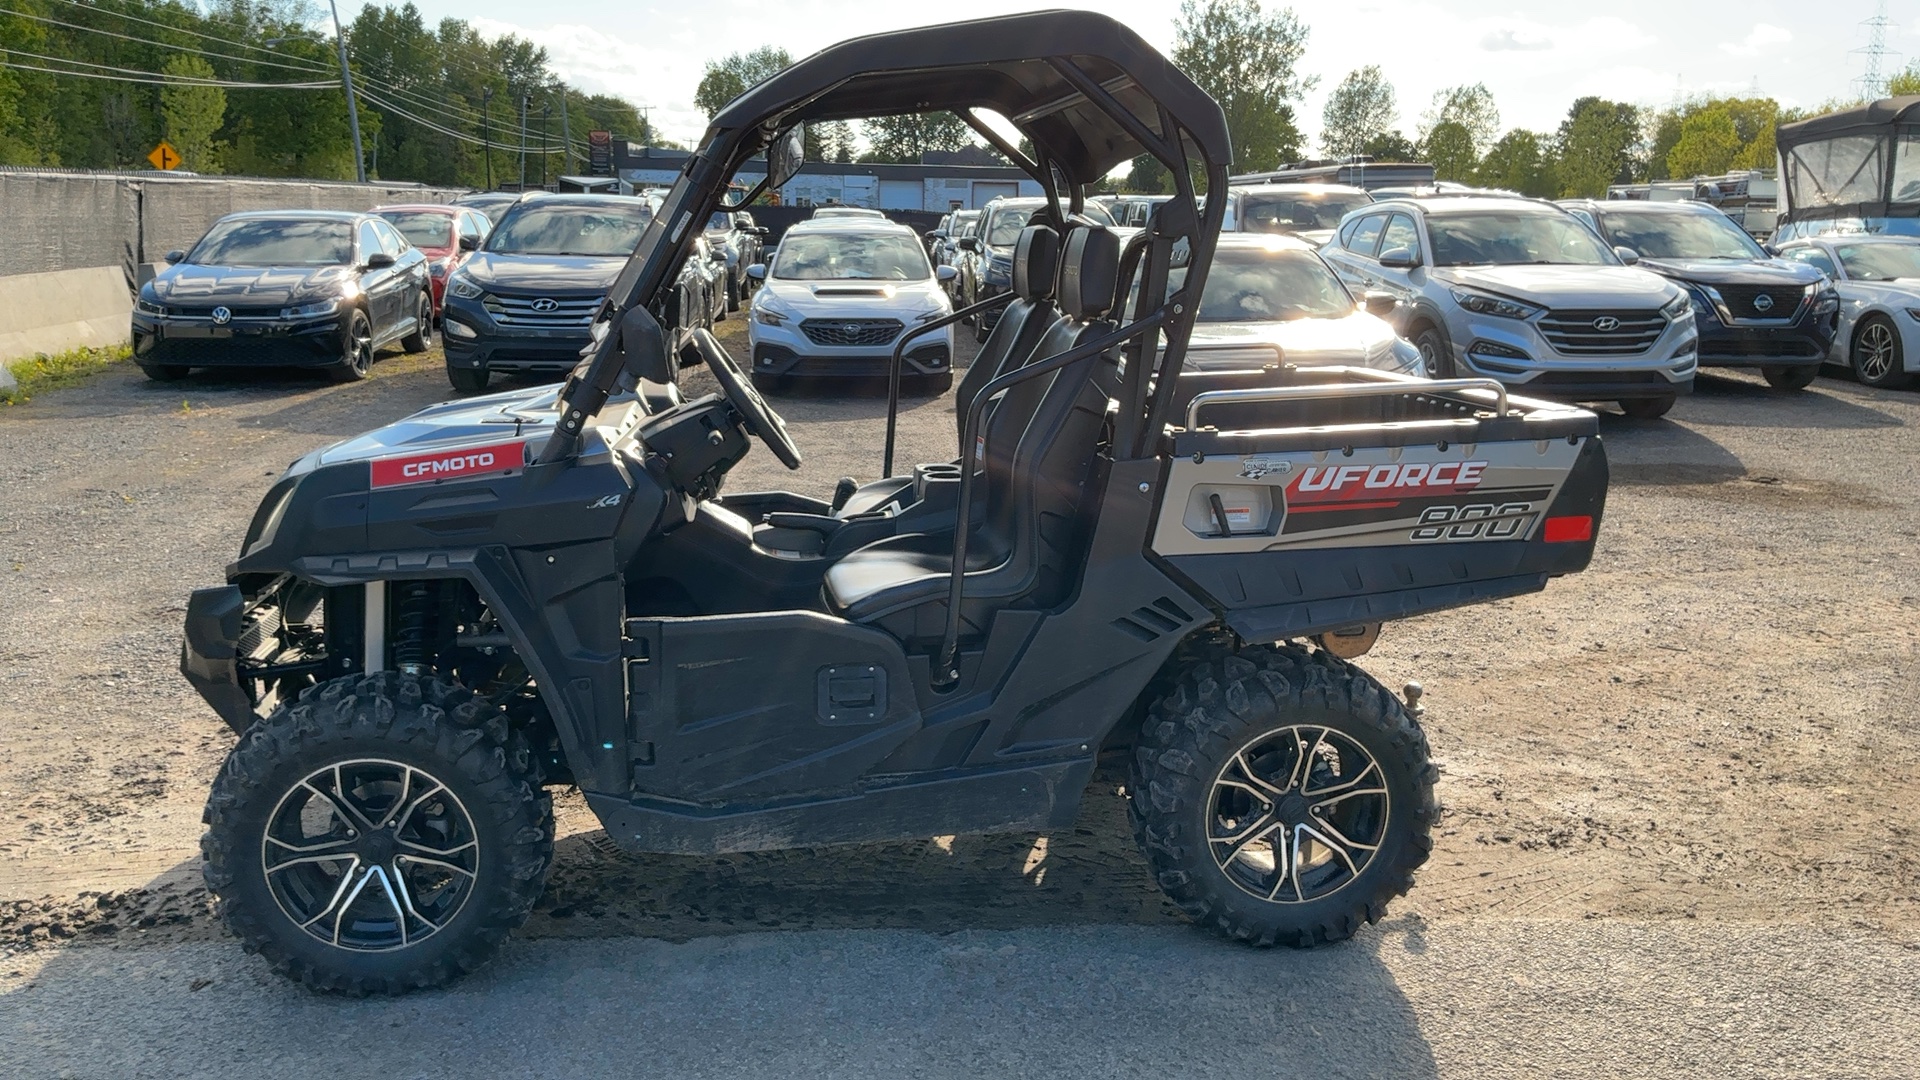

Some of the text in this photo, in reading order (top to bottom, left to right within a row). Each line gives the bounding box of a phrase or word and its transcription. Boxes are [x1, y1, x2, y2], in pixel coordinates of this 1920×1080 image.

[403, 452, 494, 478] CFMOTO
[1298, 461, 1488, 492] UFORCE
[589, 494, 621, 509] X4
[1409, 502, 1532, 542] 800
